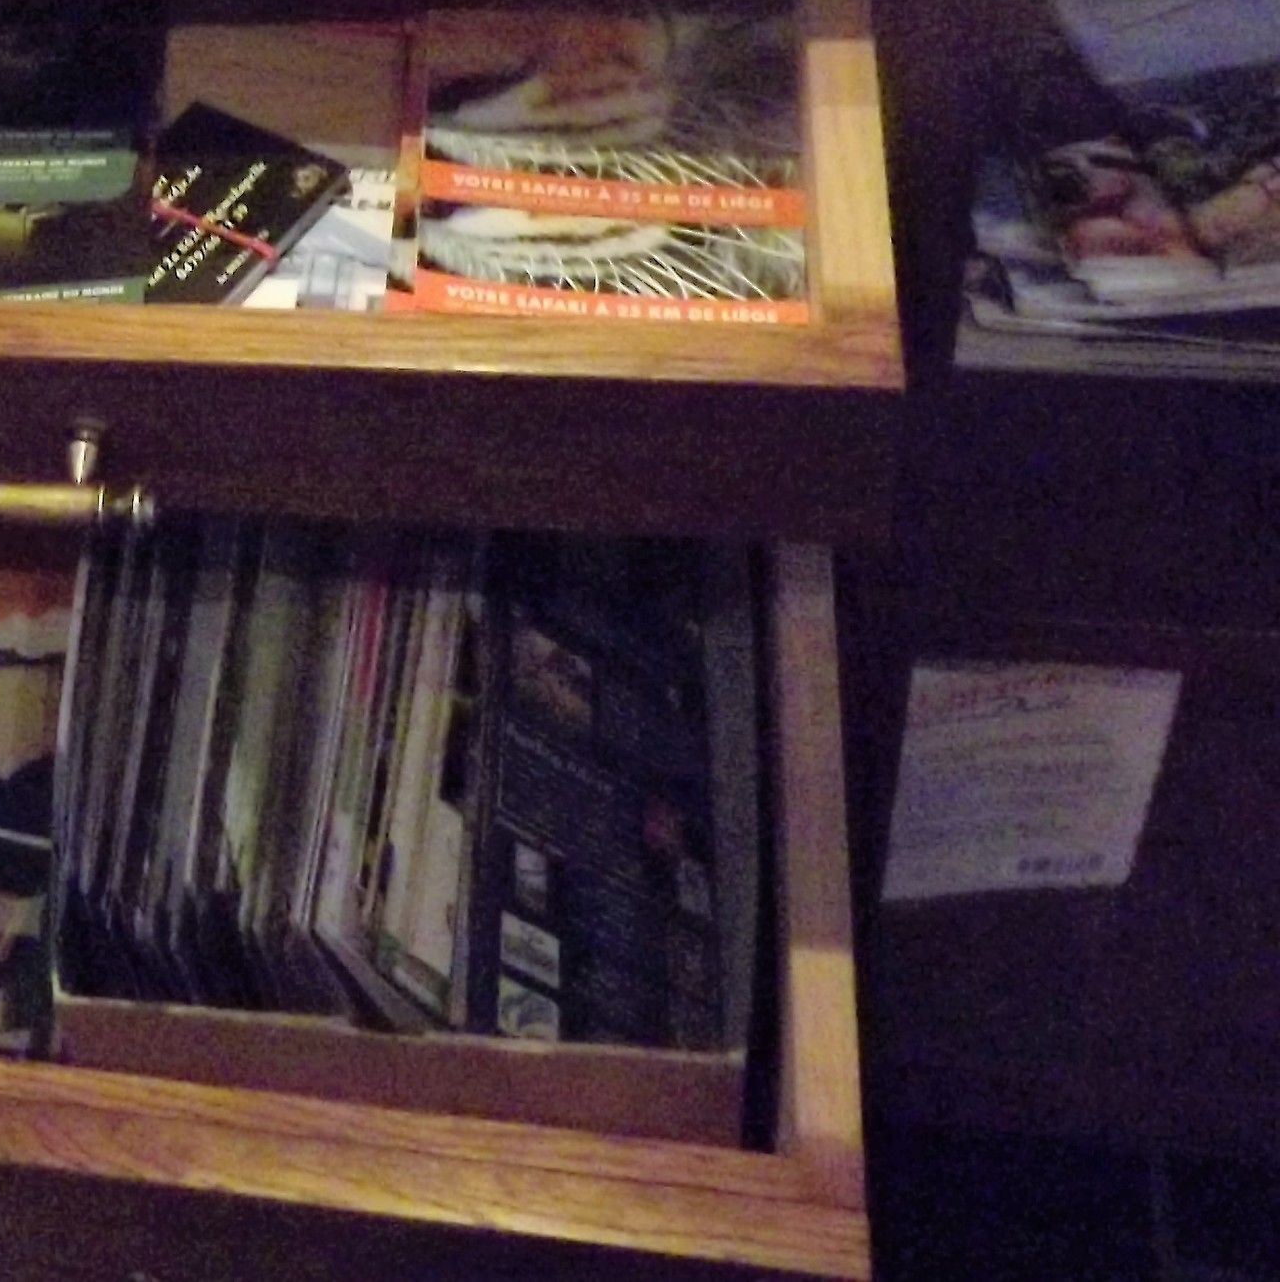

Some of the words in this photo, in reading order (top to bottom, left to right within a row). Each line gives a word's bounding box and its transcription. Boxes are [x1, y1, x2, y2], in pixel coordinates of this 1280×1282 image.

[452, 172, 512, 190] VOTRE
[521, 177, 591, 198] SAFARI
[649, 193, 681, 206] KM
[688, 194, 712, 207] DE
[446, 283, 510, 305] VOTRE
[515, 290, 589, 313] SAFARI
[649, 306, 682, 320] KM
[687, 306, 715, 321] DE
